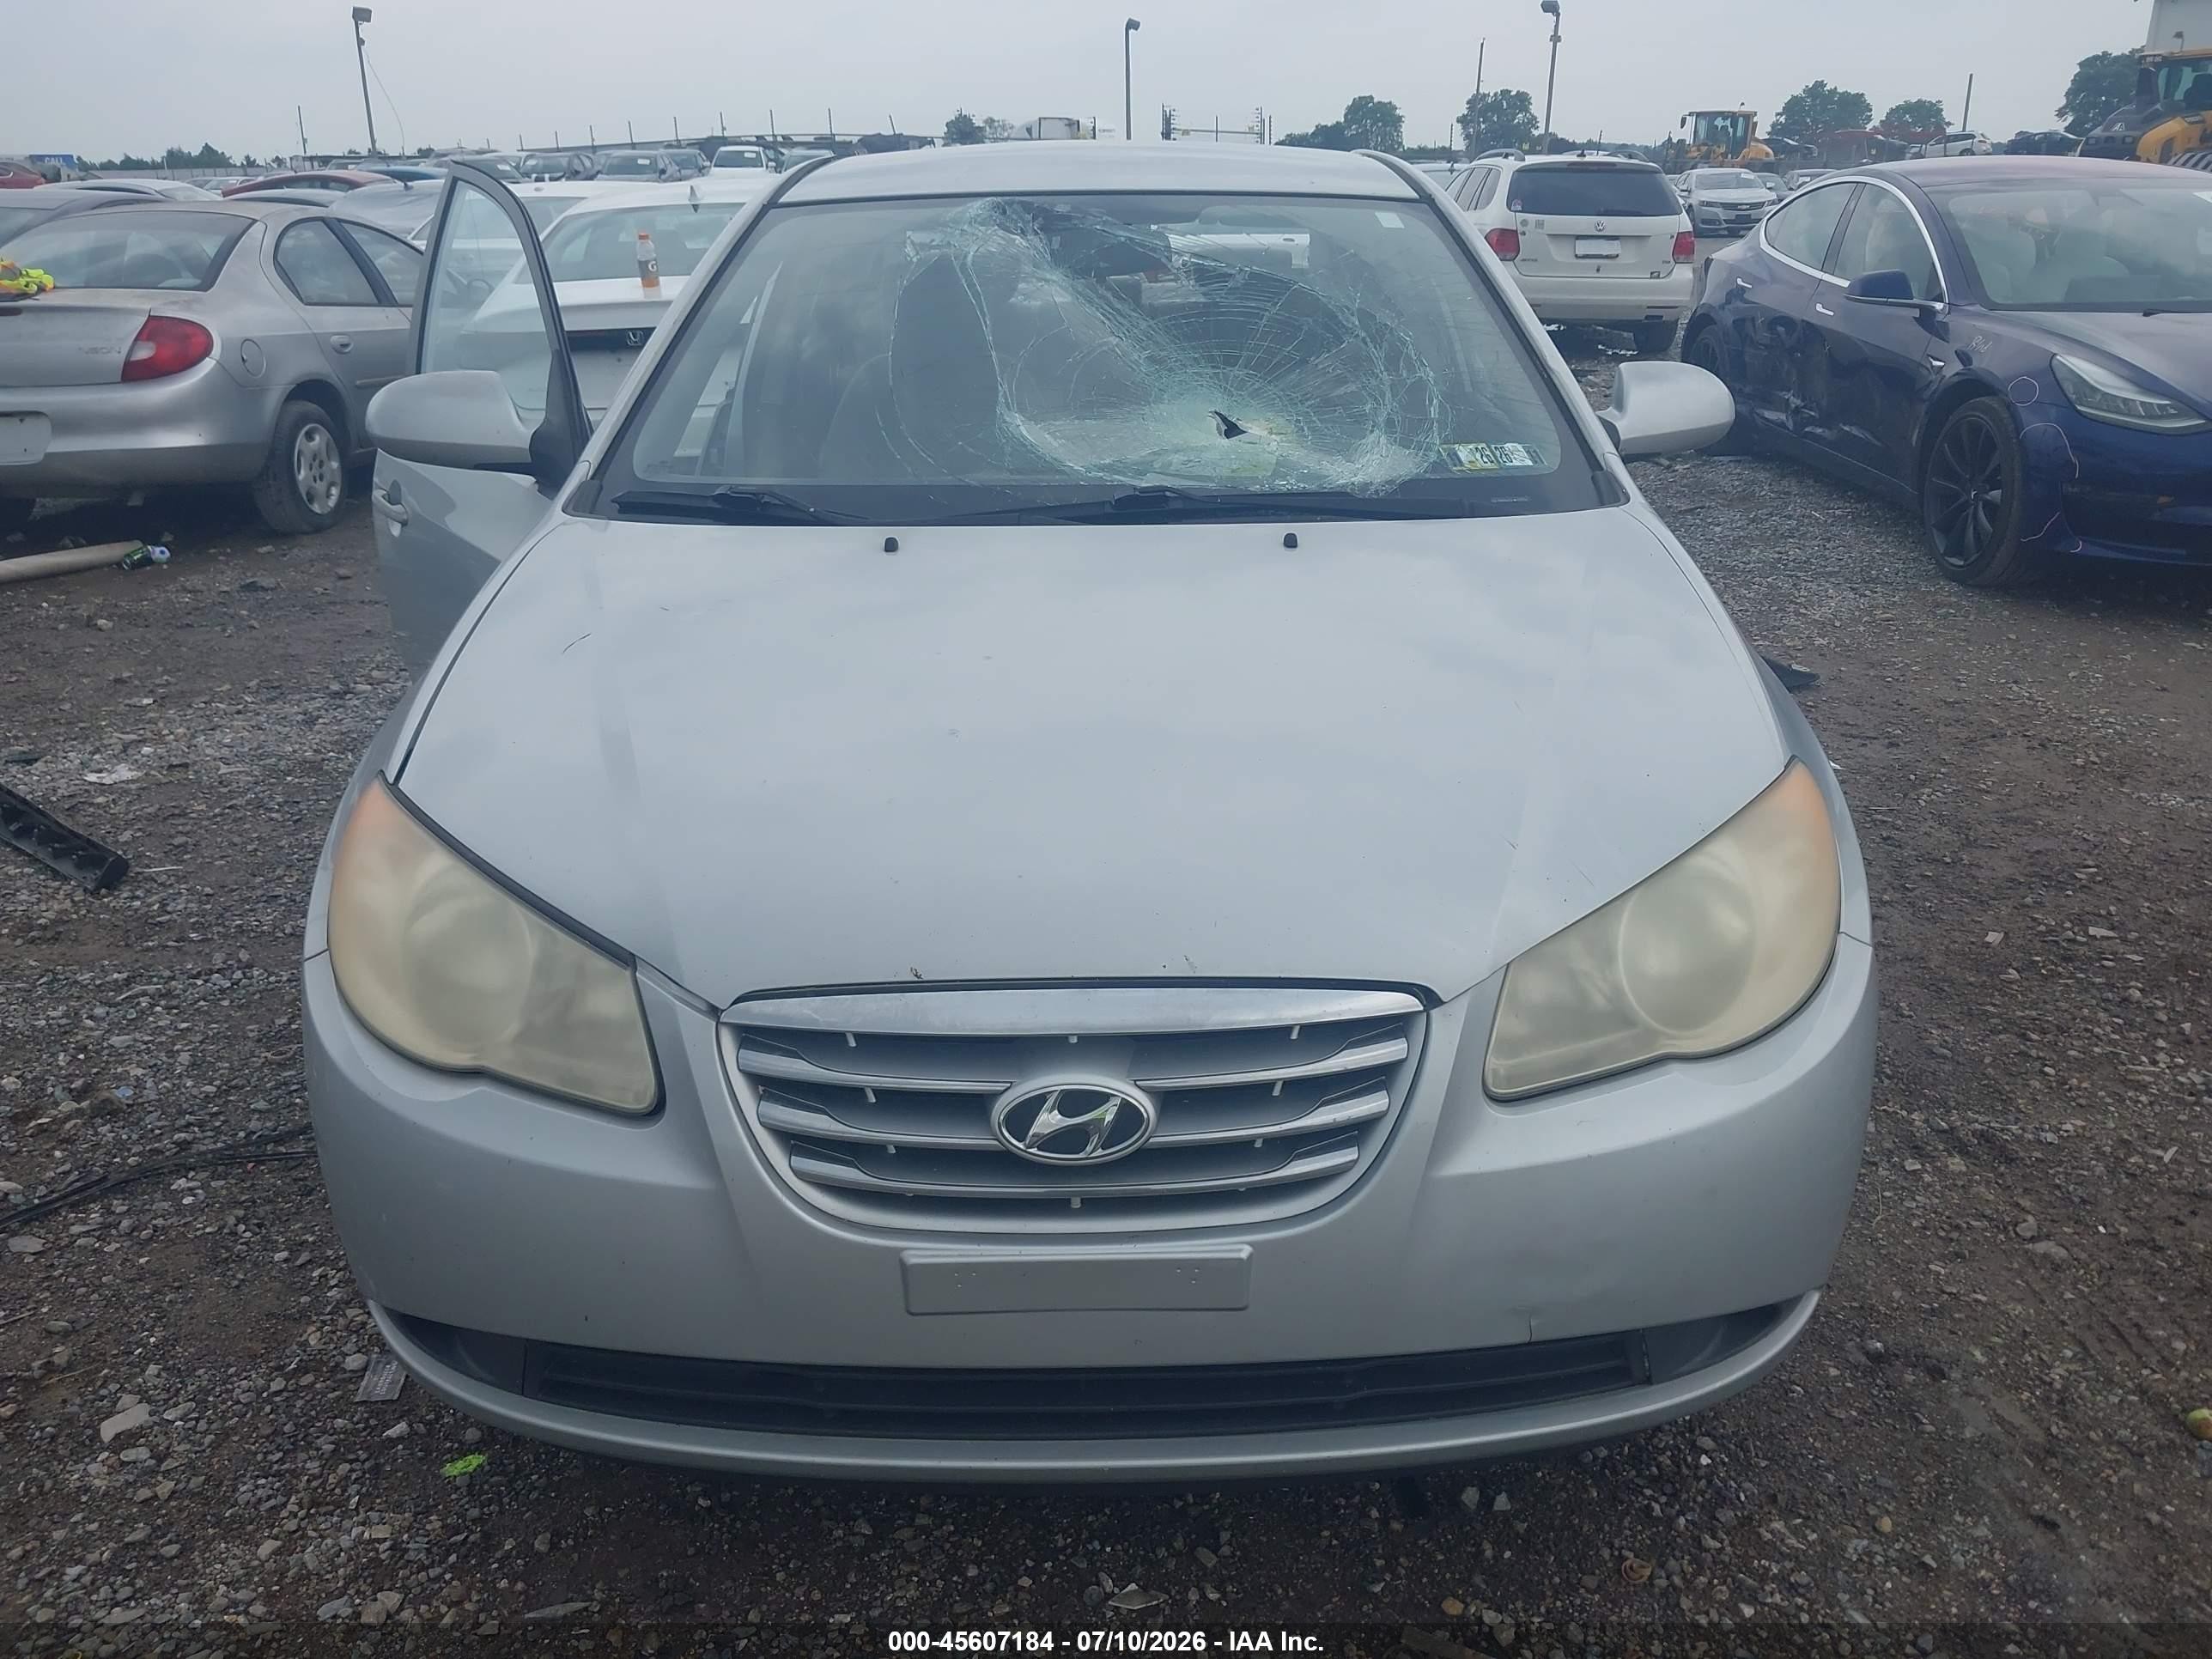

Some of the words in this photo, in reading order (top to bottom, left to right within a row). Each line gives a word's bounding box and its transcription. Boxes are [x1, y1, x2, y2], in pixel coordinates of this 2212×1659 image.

[647, 260, 658, 272] G
[1474, 446, 1494, 465] 26
[1494, 446, 1513, 464] 26
